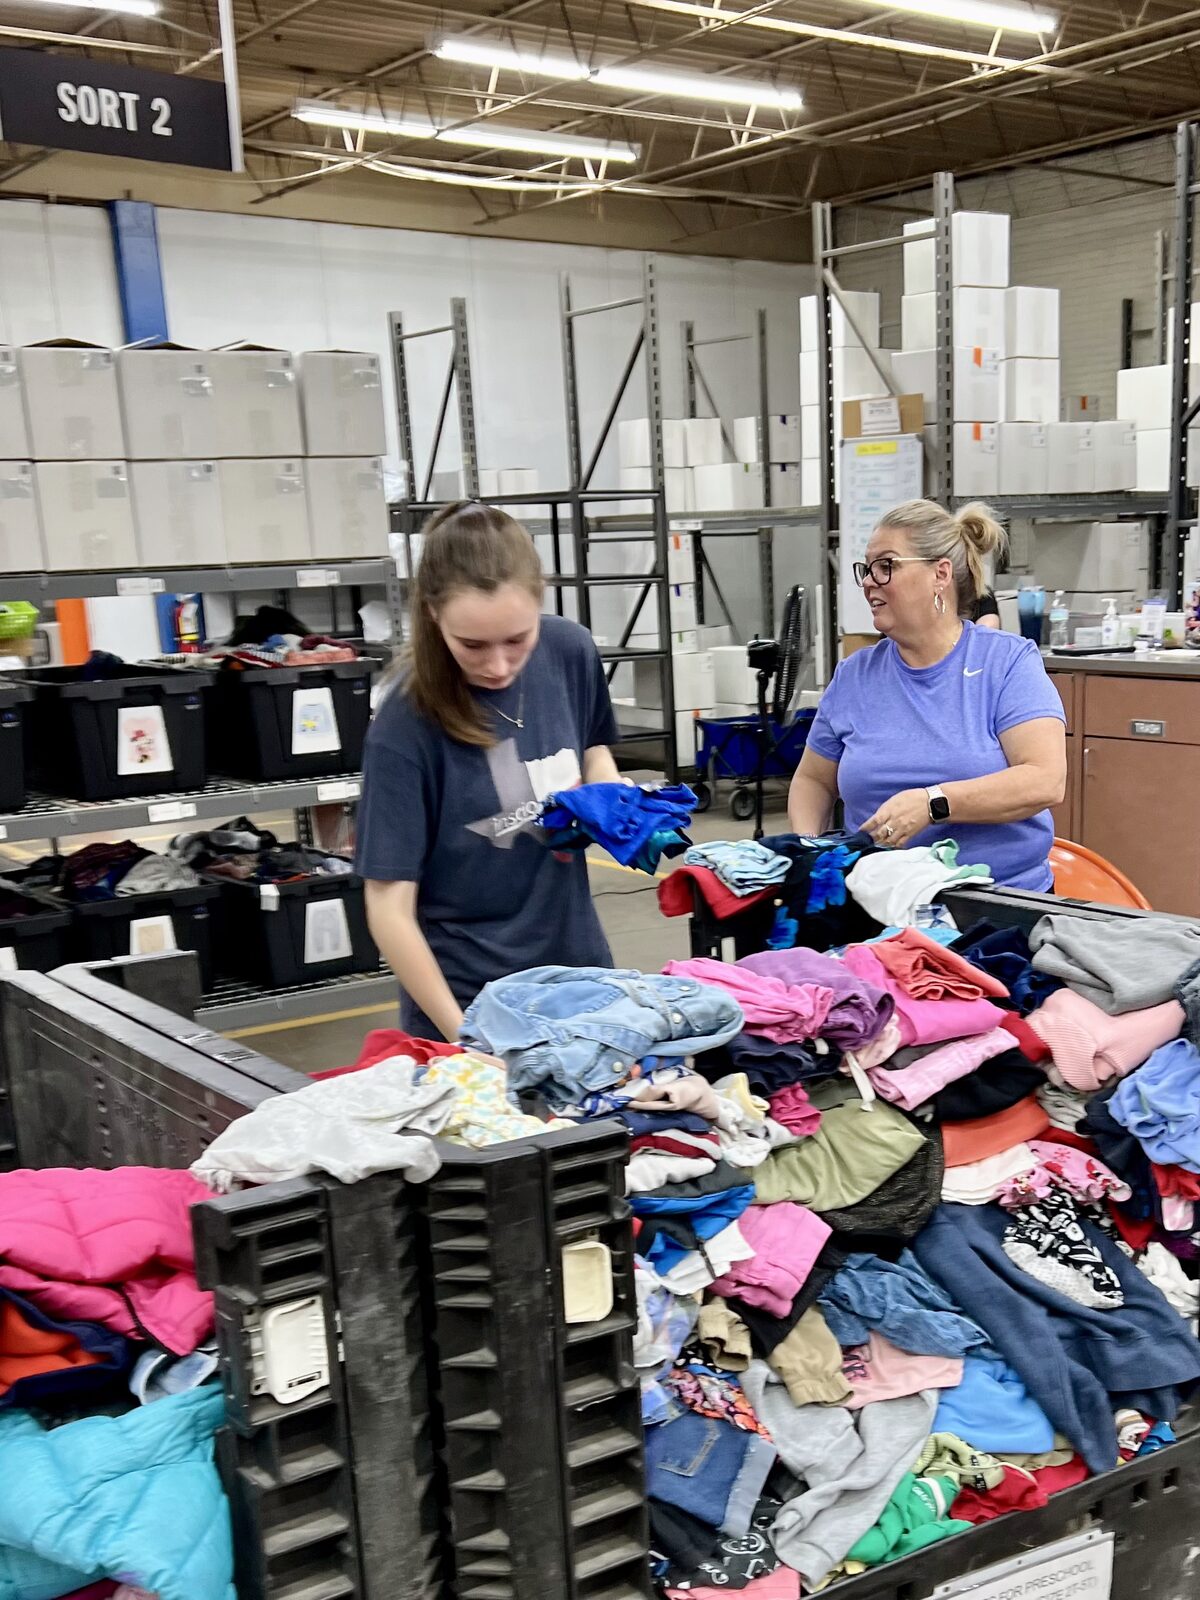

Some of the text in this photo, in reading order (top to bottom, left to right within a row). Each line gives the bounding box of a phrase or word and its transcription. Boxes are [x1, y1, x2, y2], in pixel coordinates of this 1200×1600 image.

[57, 82, 172, 136] SORT 2
[998, 1560, 1095, 1600] FOR PRESCHOOL
